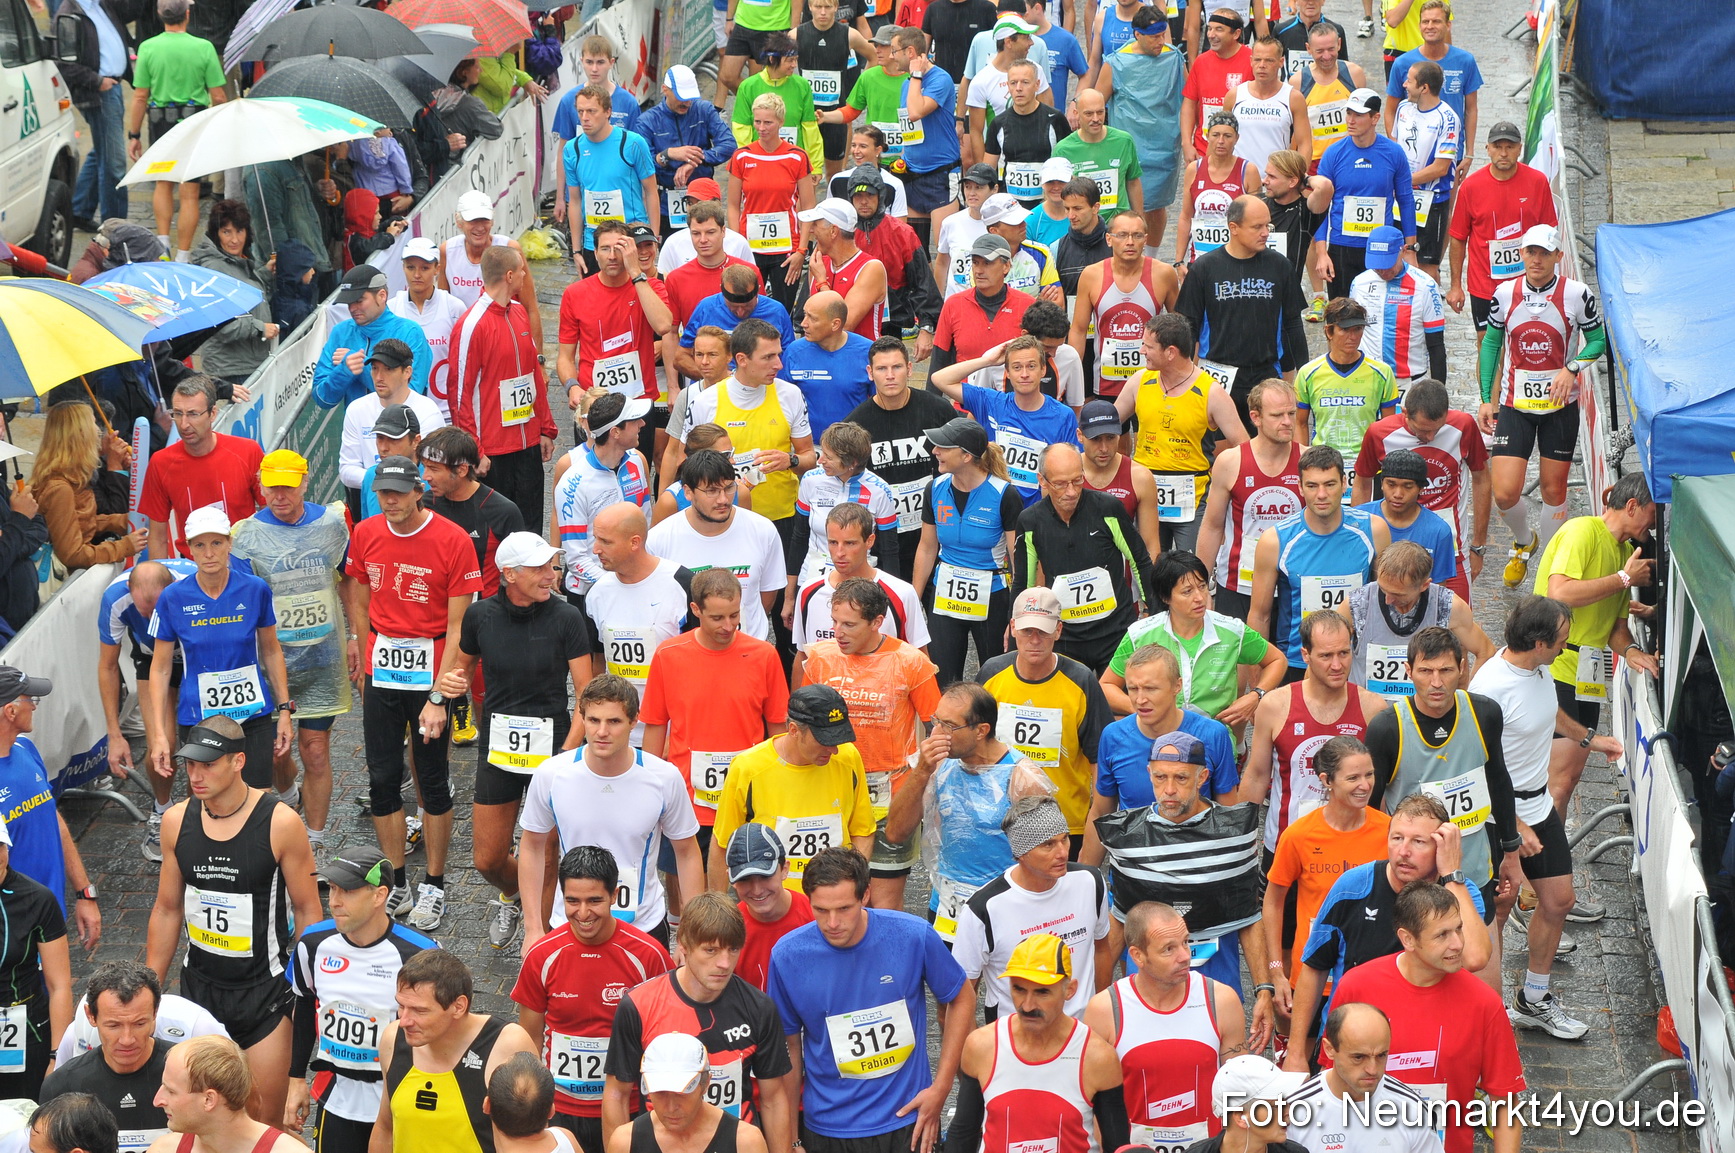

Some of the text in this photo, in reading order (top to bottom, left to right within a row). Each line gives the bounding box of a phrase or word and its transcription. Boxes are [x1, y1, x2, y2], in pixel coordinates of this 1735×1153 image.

[1240, 106, 1281, 117] ERDINGER
[1318, 110, 1342, 126] 410
[1009, 173, 1040, 186] 2315
[594, 202, 611, 215] 22
[1200, 201, 1226, 212] LAC
[1356, 207, 1374, 223] 93
[759, 224, 777, 238] 79
[1354, 224, 1375, 233] Rupert
[1195, 228, 1230, 243] 3403
[452, 276, 483, 287] Oberb
[1241, 277, 1275, 289] HiRo
[1112, 324, 1140, 333] LAC
[428, 333, 447, 346] ank
[1521, 341, 1549, 351] LAC
[1111, 351, 1140, 366] 159
[596, 364, 638, 388] 2351
[509, 386, 533, 408] 126
[1320, 395, 1366, 407] BOCK
[892, 436, 930, 460] TX
[129, 426, 141, 491] ReiseCenter
[1007, 470, 1027, 481] dreas
[1421, 475, 1447, 490] AC
[1256, 504, 1290, 515] LAC
[902, 514, 922, 525] Feli
[400, 563, 433, 574] NEUMARKTER
[946, 579, 979, 602] 155
[1070, 583, 1097, 605] 72
[182, 603, 206, 612] HEITEC
[947, 601, 972, 613] Sabine
[1070, 603, 1105, 618] Reinhard
[191, 614, 243, 627] LAC QUELLE
[280, 604, 328, 629] 2253
[295, 628, 318, 639] Heinz
[815, 629, 836, 639] GER
[610, 642, 645, 663] 209
[1386, 647, 1408, 656] BOC
[378, 648, 428, 670] 3094
[391, 672, 412, 683] Klaus
[618, 668, 641, 677] Lothar
[206, 680, 257, 708] 3283
[1383, 684, 1414, 695] Johann
[1014, 721, 1042, 745] 62
[508, 731, 531, 752] 91
[509, 756, 529, 767] Luigi
[1020, 750, 1047, 760] annes
[706, 792, 721, 802] Chri
[1445, 790, 1473, 816] 75
[2, 789, 53, 825] LAC QUELLE
[788, 832, 830, 857] 283
[208, 865, 239, 875] Marathon
[1309, 862, 1340, 874] EURO
[196, 872, 236, 882] Regensburg
[202, 906, 229, 933] 15
[1019, 912, 1075, 937] Deutsche Meisterschaft
[201, 932, 229, 948] Martin
[851, 1010, 883, 1024] BOCK
[324, 1012, 378, 1048] 2091
[723, 1023, 752, 1043] T90
[570, 1040, 600, 1049] BOCK
[847, 1023, 899, 1058] 312
[330, 1044, 368, 1061] Andreas
[557, 1051, 602, 1079] 212
[860, 1055, 896, 1073] Fabian
[1399, 1056, 1422, 1066] DEHN
[569, 1082, 604, 1094] Furkan
[1161, 1100, 1183, 1112] DEHN
[1153, 1130, 1186, 1139] BOCK
[1022, 1143, 1044, 1153] DEHN
